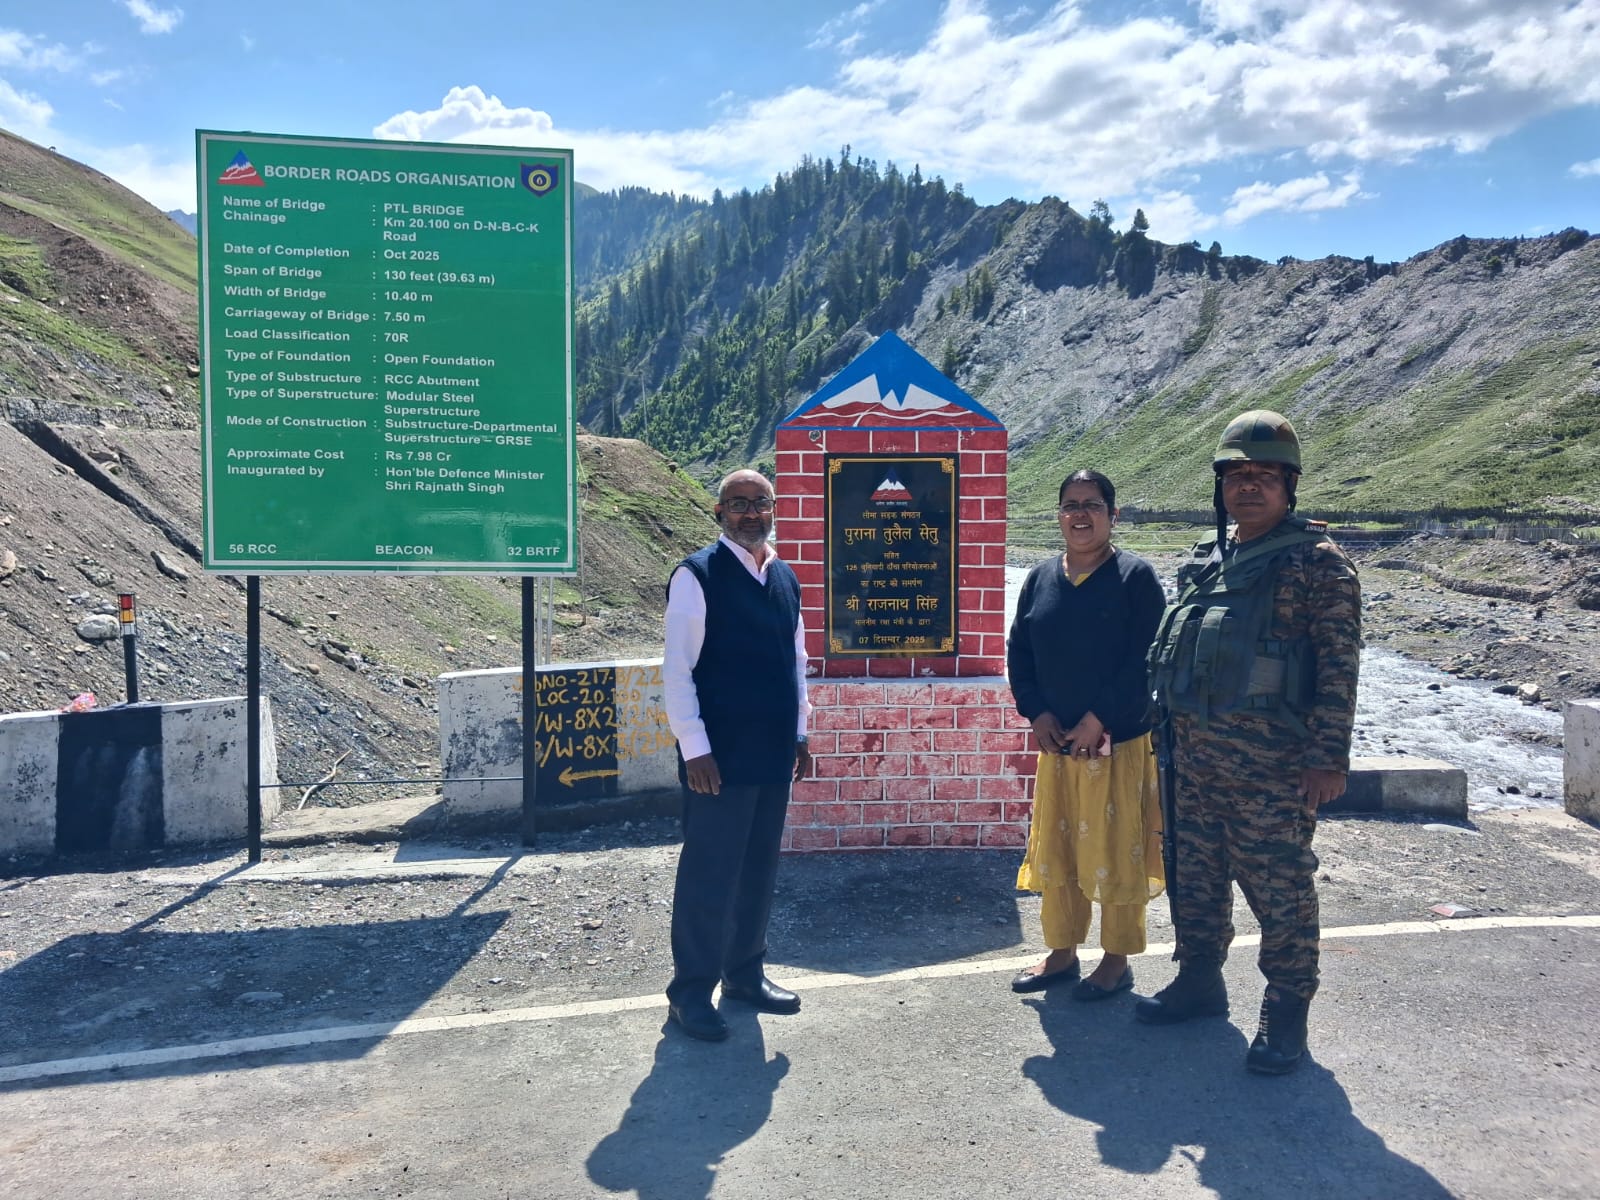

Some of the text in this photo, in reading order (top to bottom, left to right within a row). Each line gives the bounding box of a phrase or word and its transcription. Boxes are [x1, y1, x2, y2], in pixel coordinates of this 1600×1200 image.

[263, 164, 516, 189] BORDER ROADS ORGANISATION
[223, 195, 262, 207] Name
[263, 198, 279, 208] of
[282, 198, 326, 212] Bridge
[383, 203, 409, 213] PTL
[412, 204, 465, 216] BRIDGE
[223, 210, 287, 224] Chainage
[383, 217, 405, 228] Km
[409, 218, 450, 229] 20.100
[453, 221, 470, 230] on
[473, 220, 540, 233] D-N-B-C-K
[383, 230, 417, 242] Road
[223, 243, 255, 254] Date
[257, 244, 272, 254] of
[274, 245, 350, 258] Completion
[383, 249, 407, 259] Oct
[409, 250, 440, 261] 2025
[223, 264, 258, 277] Span
[261, 265, 276, 276] of
[278, 267, 323, 279] Bridge
[384, 270, 407, 280] 130
[409, 270, 435, 281] feet
[437, 271, 476, 284] (39.63
[478, 273, 496, 286] m)
[223, 286, 263, 297] Width
[266, 287, 281, 297] of
[283, 287, 327, 300] Bridge
[384, 291, 418, 302] 10.40
[421, 294, 433, 302] m
[224, 307, 307, 321] Carriageway
[309, 309, 324, 319] of
[327, 310, 370, 323] Bridge
[383, 311, 411, 322] 7.50
[413, 314, 426, 322] m
[225, 328, 258, 338] Load
[261, 329, 351, 341] Classification
[383, 332, 409, 343] 70R
[224, 349, 257, 362] Type
[259, 350, 274, 360] of
[277, 350, 351, 362] Foundation
[384, 353, 419, 365] Open
[422, 355, 496, 366] Foundation
[225, 370, 257, 383] Type
[260, 371, 274, 381] of
[276, 371, 362, 383] Substructure
[384, 374, 414, 385] RCC
[416, 375, 481, 387] Abutment
[225, 387, 258, 399] Type
[260, 387, 275, 398] of
[386, 391, 439, 402] Modular
[442, 392, 475, 403] Steel
[383, 404, 481, 417] Superstructure
[226, 415, 263, 426] Mode
[265, 415, 280, 426] of
[282, 415, 367, 428] Construction
[384, 432, 481, 445] Superstructure
[495, 435, 533, 446] GRSE
[226, 447, 311, 460] Approximate
[313, 449, 345, 460] Cost
[385, 451, 403, 461] Rs
[406, 451, 433, 462] 7.98
[436, 451, 452, 462] Cr
[226, 464, 306, 477] Inaugurated
[309, 465, 325, 478] by
[438, 468, 491, 479] Defence
[494, 469, 545, 480] Minister
[385, 480, 505, 494] Shri Rajnath Singh
[844, 523, 939, 545] पुराना तुलैल सेतु
[229, 543, 277, 554] 56 RCC
[375, 544, 434, 555] BEACON
[507, 546, 561, 556] 32 BRTF
[845, 594, 939, 611] श्री राजनाथ सिंह
[858, 636, 869, 645] 07
[904, 635, 925, 645] 2025
